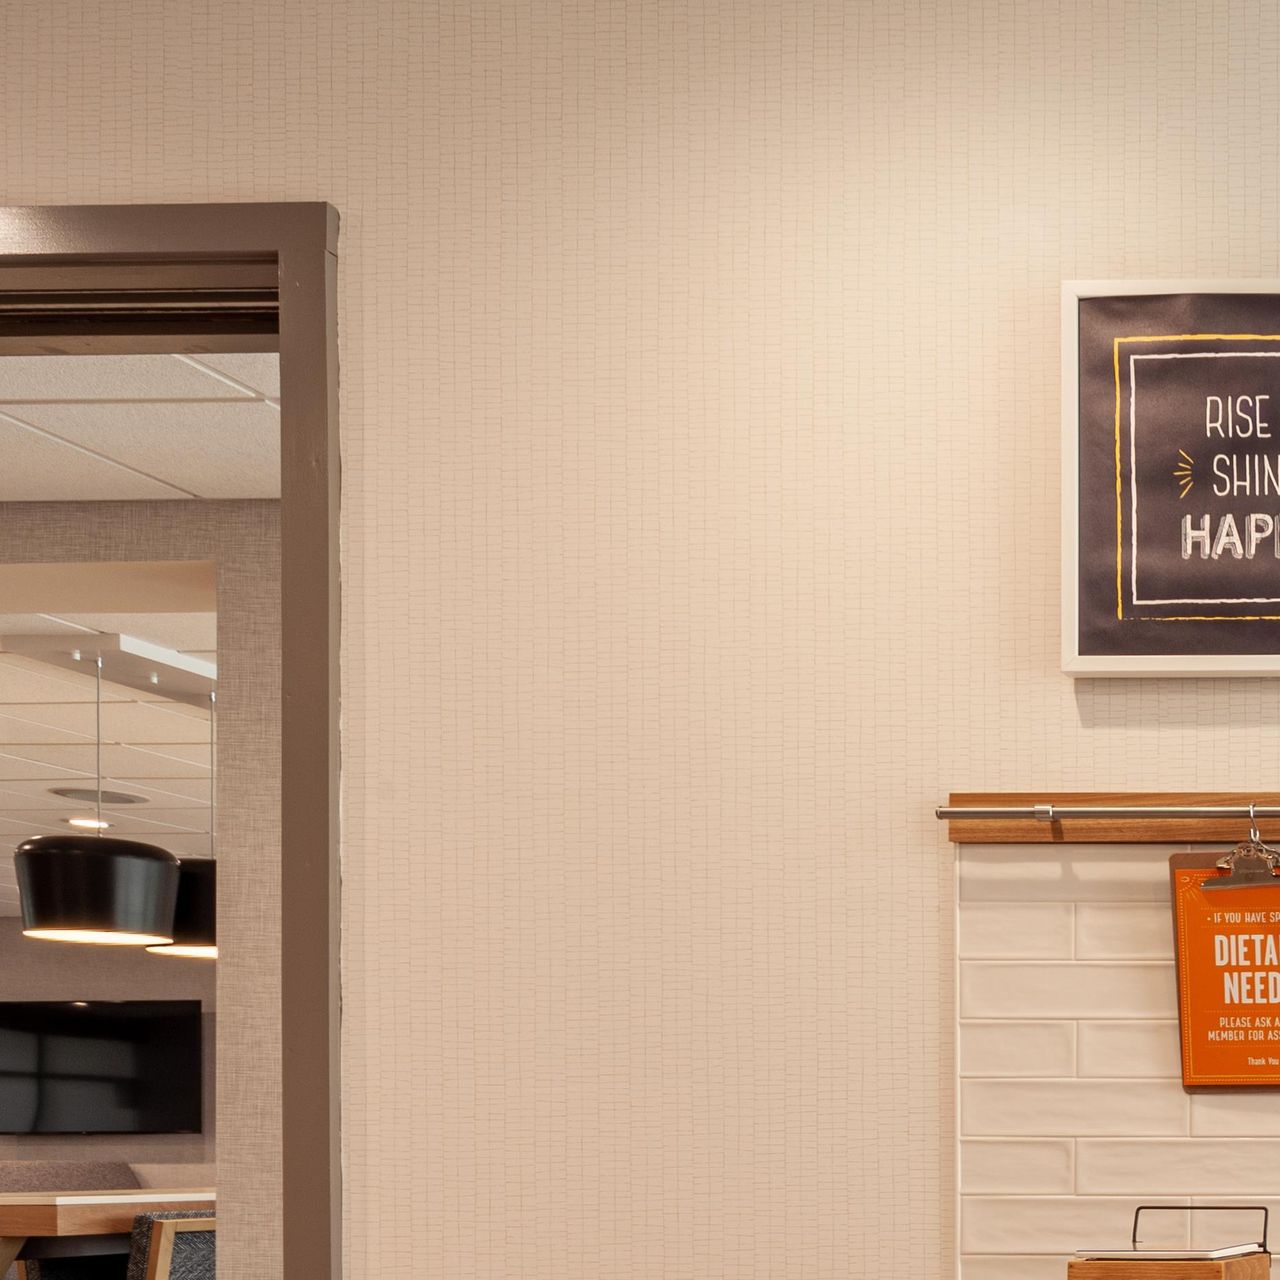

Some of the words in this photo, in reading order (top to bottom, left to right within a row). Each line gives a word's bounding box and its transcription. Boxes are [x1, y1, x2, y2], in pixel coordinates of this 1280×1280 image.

[1206, 395, 1271, 438] RISE
[1214, 913, 1222, 923] IF
[1224, 912, 1241, 923] YOU
[1245, 912, 1266, 923] HAVE
[1219, 1017, 1251, 1027] PLEASE
[1255, 1017, 1272, 1027] ASK
[1275, 1017, 1280, 1027] A
[1208, 1031, 1244, 1041] MEMBER
[1248, 1030, 1264, 1041] FOR
[1248, 1057, 1265, 1065] Thank
[1268, 1057, 1279, 1065] You
